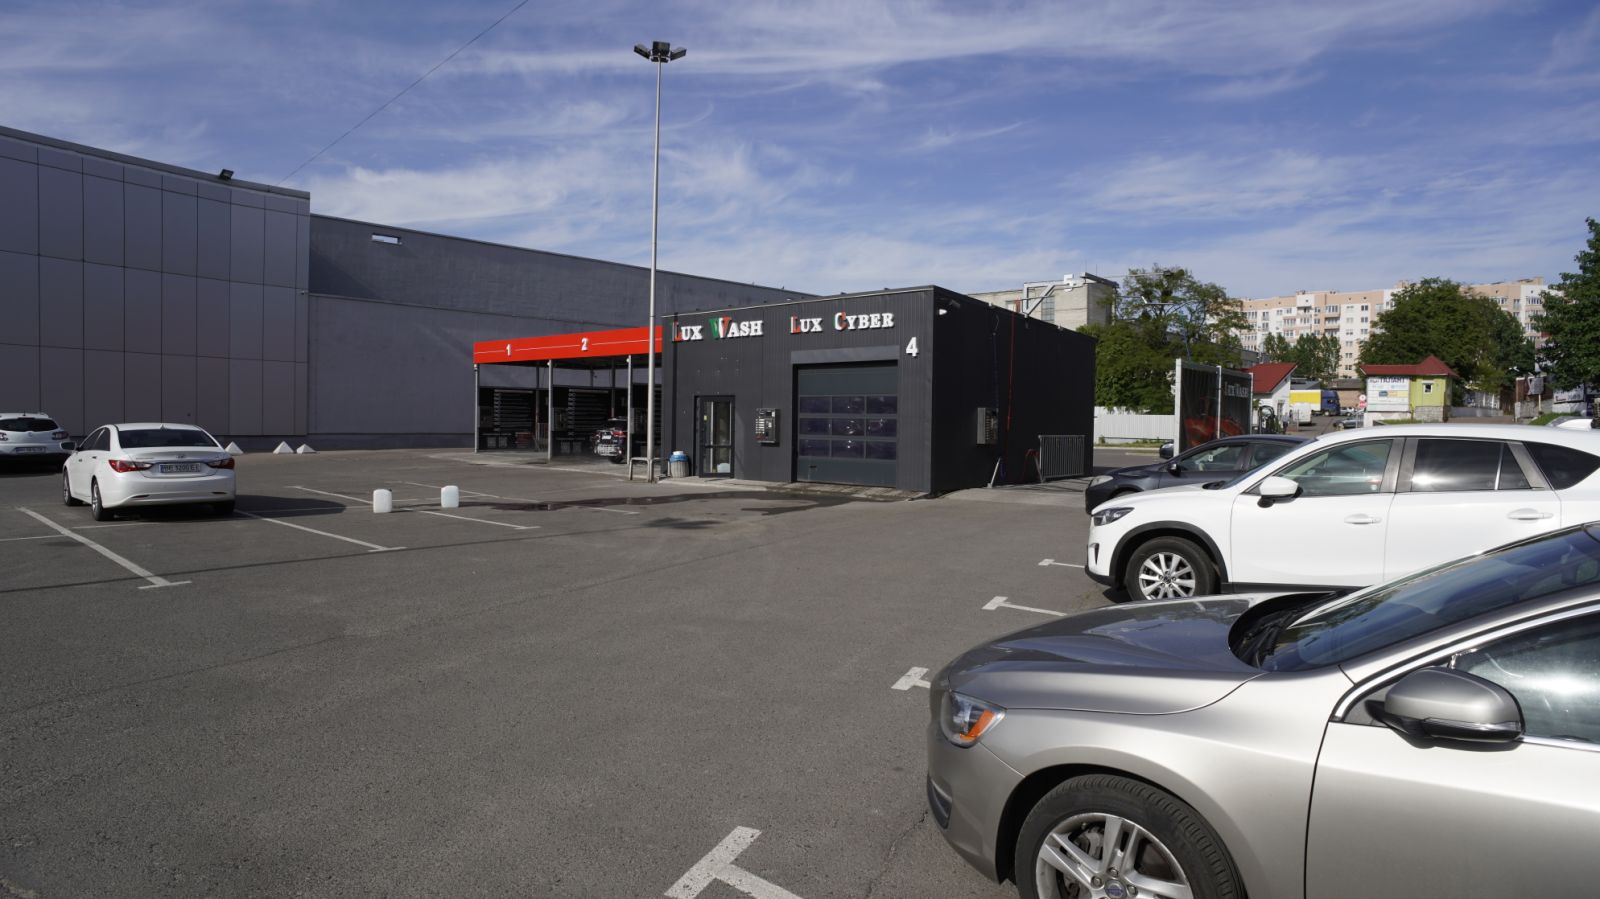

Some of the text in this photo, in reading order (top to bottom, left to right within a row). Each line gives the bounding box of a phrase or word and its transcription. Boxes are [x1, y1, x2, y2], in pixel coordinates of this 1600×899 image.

[709, 316, 764, 339] WASH
[790, 311, 895, 334] LUX CYBER
[505, 343, 512, 357] 1
[581, 337, 589, 351] 2
[905, 336, 919, 357] 4
